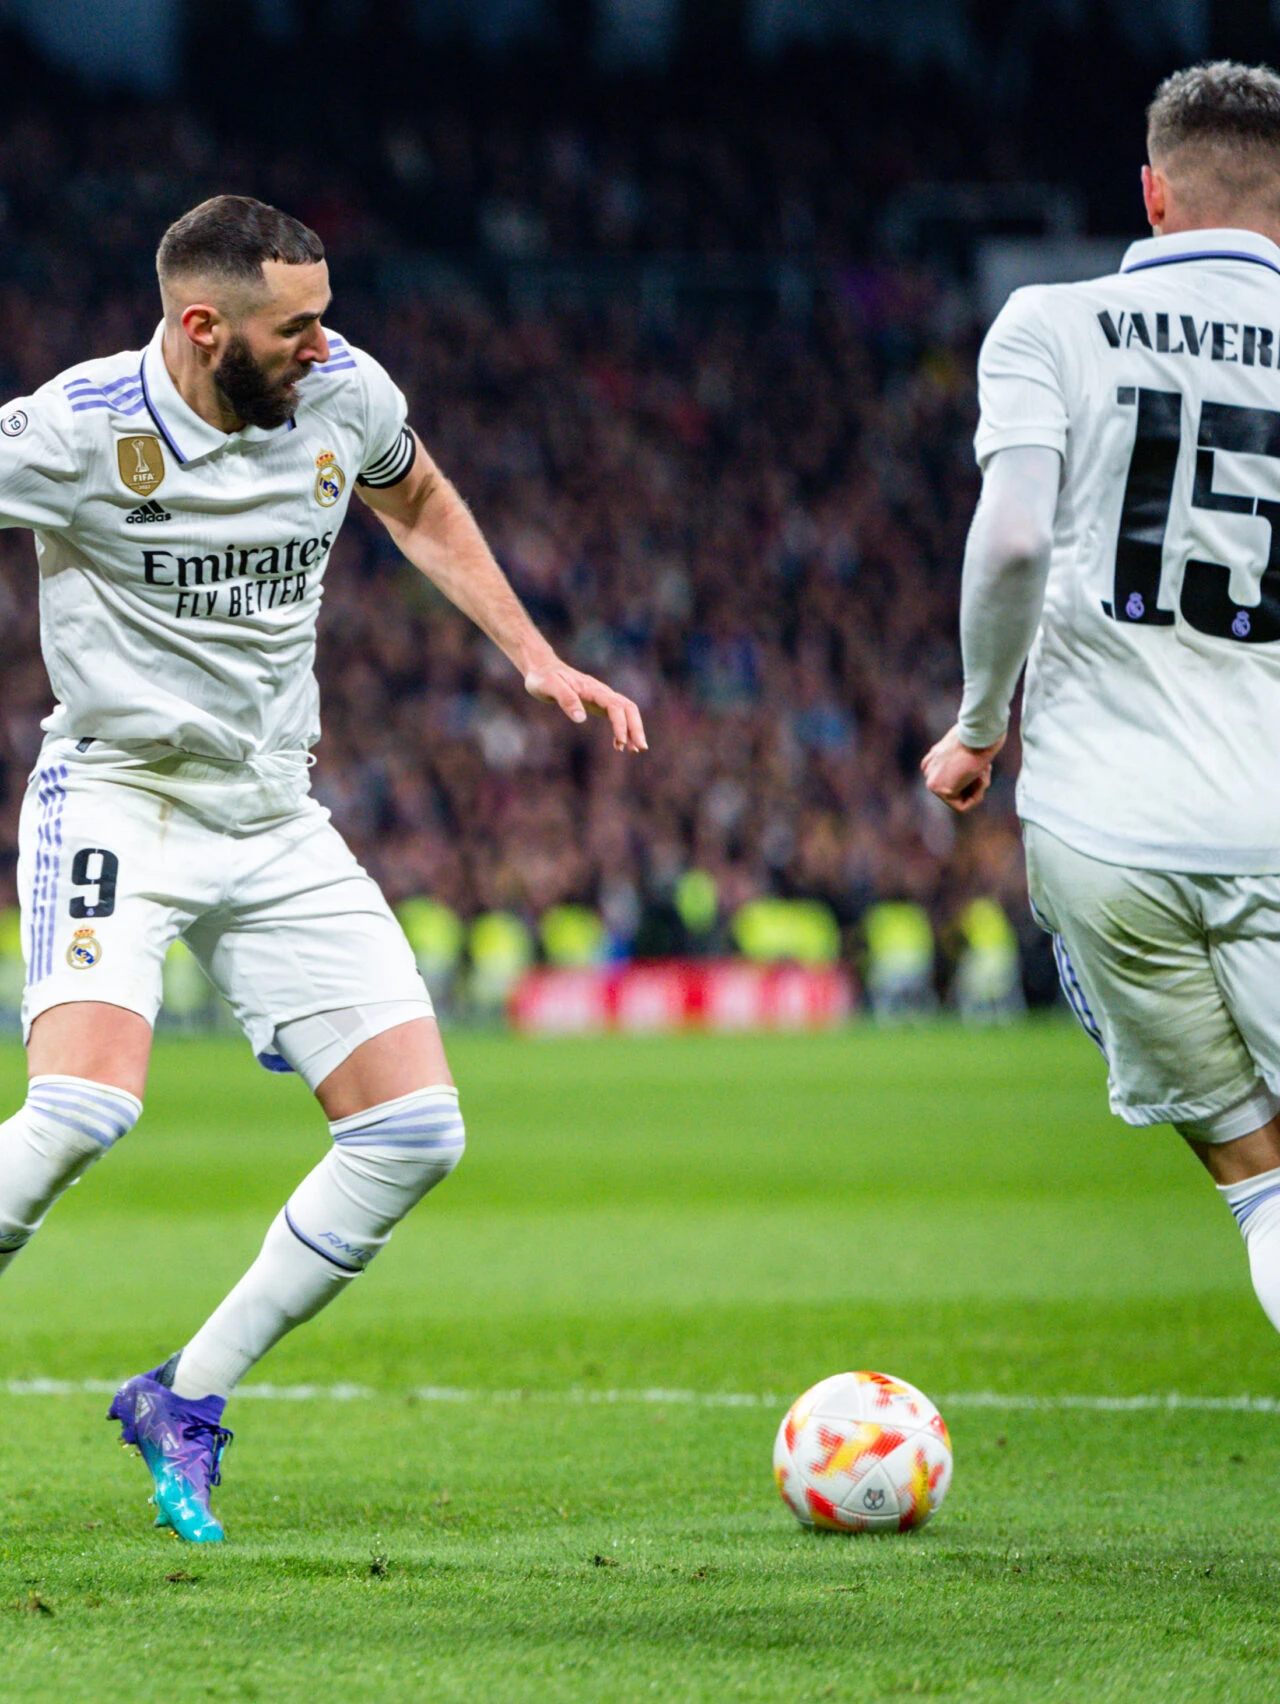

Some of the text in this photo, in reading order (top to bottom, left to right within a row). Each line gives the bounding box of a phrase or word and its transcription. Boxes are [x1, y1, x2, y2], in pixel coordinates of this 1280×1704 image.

[1097, 309, 1280, 371] VALVER
[8, 415, 22, 431] 19
[133, 473, 154, 482] FIFA
[126, 512, 172, 524] adidas
[1101, 386, 1280, 643] 15
[141, 531, 333, 587] Emirates
[176, 571, 307, 618] FLY BETTER
[68, 847, 119, 919] 9
